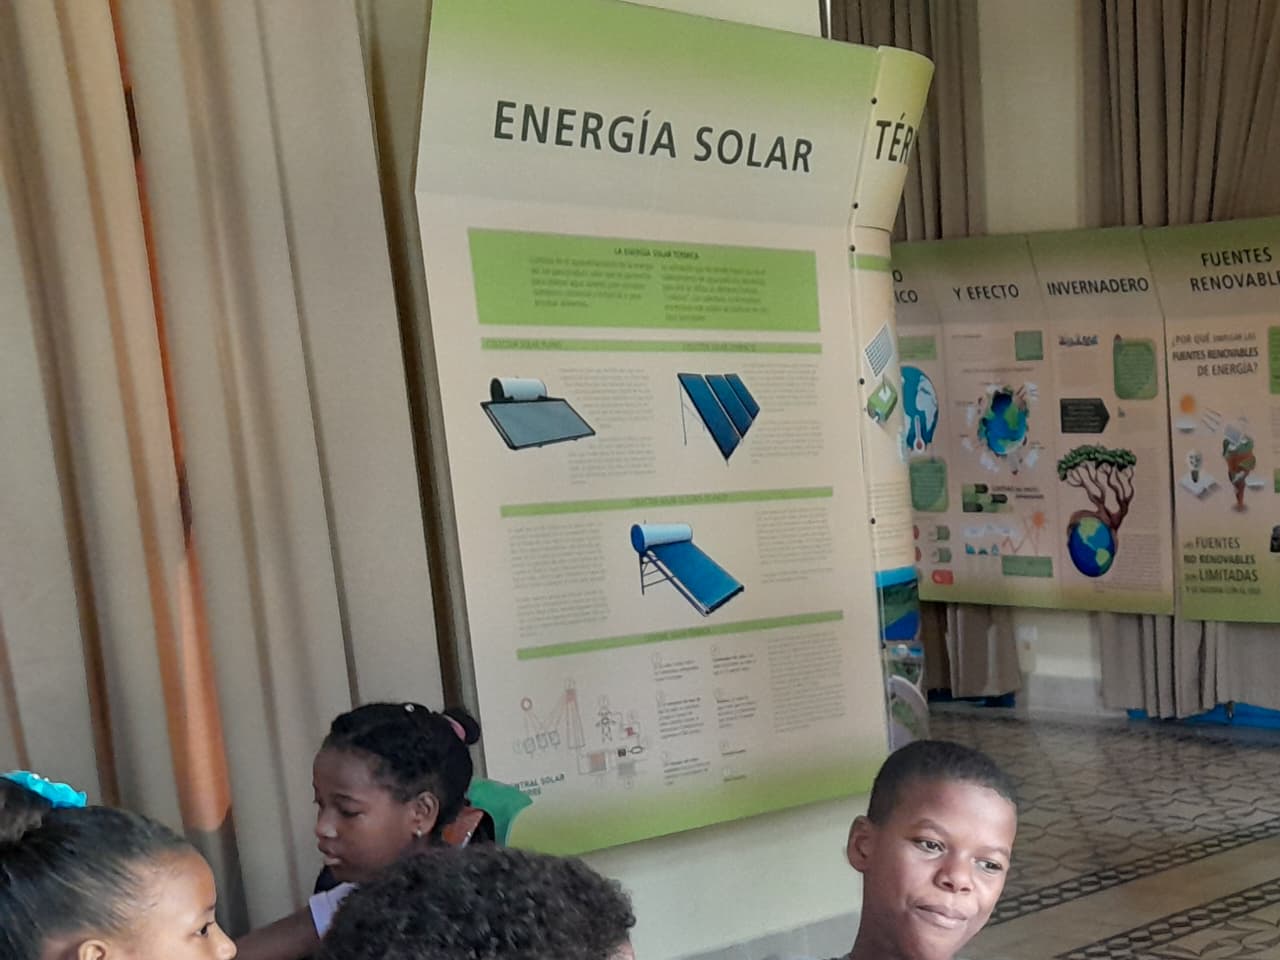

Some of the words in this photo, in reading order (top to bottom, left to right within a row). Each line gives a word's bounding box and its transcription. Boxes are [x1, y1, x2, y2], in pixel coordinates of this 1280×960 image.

[493, 99, 677, 159] ENERGÍA
[693, 125, 813, 174] SOLAR
[876, 111, 914, 165] TÉR
[1201, 246, 1273, 268] FUENTES
[894, 289, 918, 304] ICO
[952, 286, 962, 301] Y
[967, 284, 1020, 301] EFECTO
[1047, 277, 1150, 297] INVERNADERO
[1195, 535, 1241, 549] FUENTES
